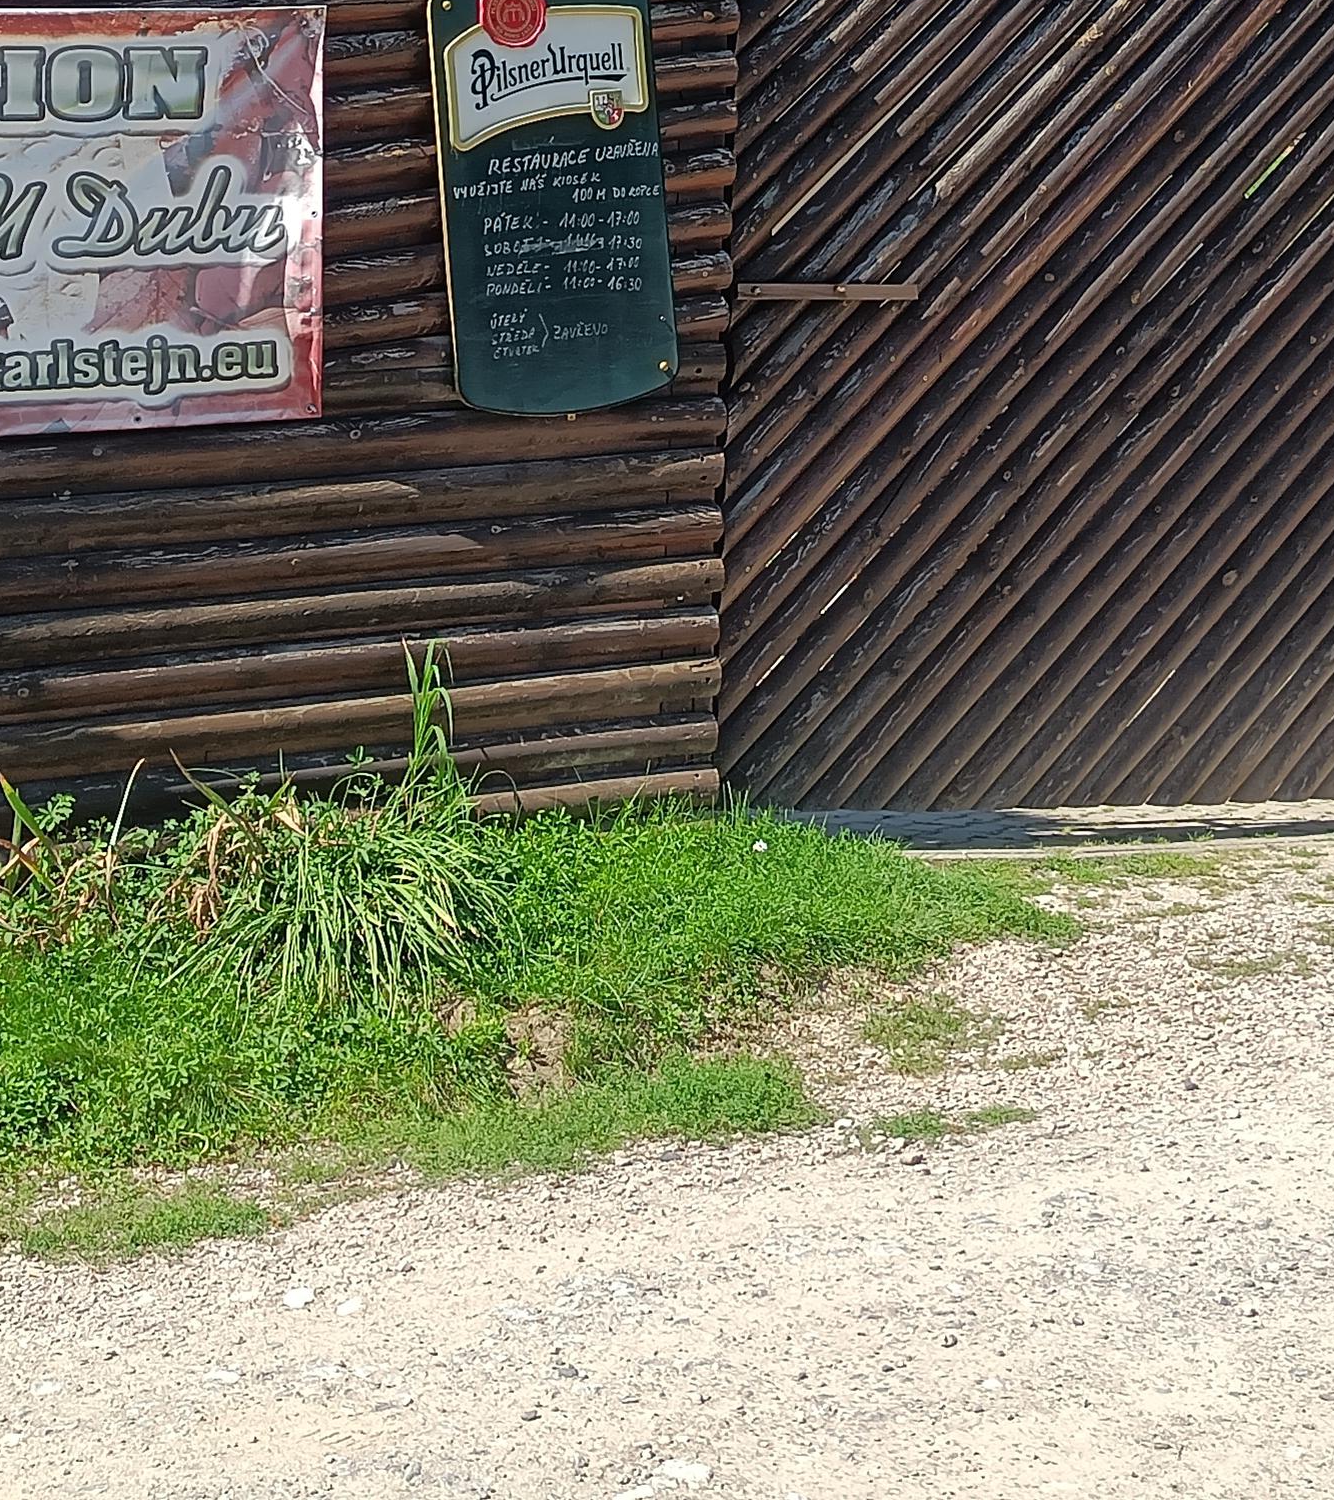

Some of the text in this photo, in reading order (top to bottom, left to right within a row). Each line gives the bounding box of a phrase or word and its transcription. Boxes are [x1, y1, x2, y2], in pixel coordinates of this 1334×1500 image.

[470, 43, 624, 111] Pilsner Urquell
[488, 147, 590, 176] RESTAURACE
[595, 138, 659, 163] UZAVŘENA
[453, 171, 601, 200] VYUŽIJTE NÁŠ KIOSEK
[571, 187, 594, 203] 100
[52, 165, 287, 258] Dubu
